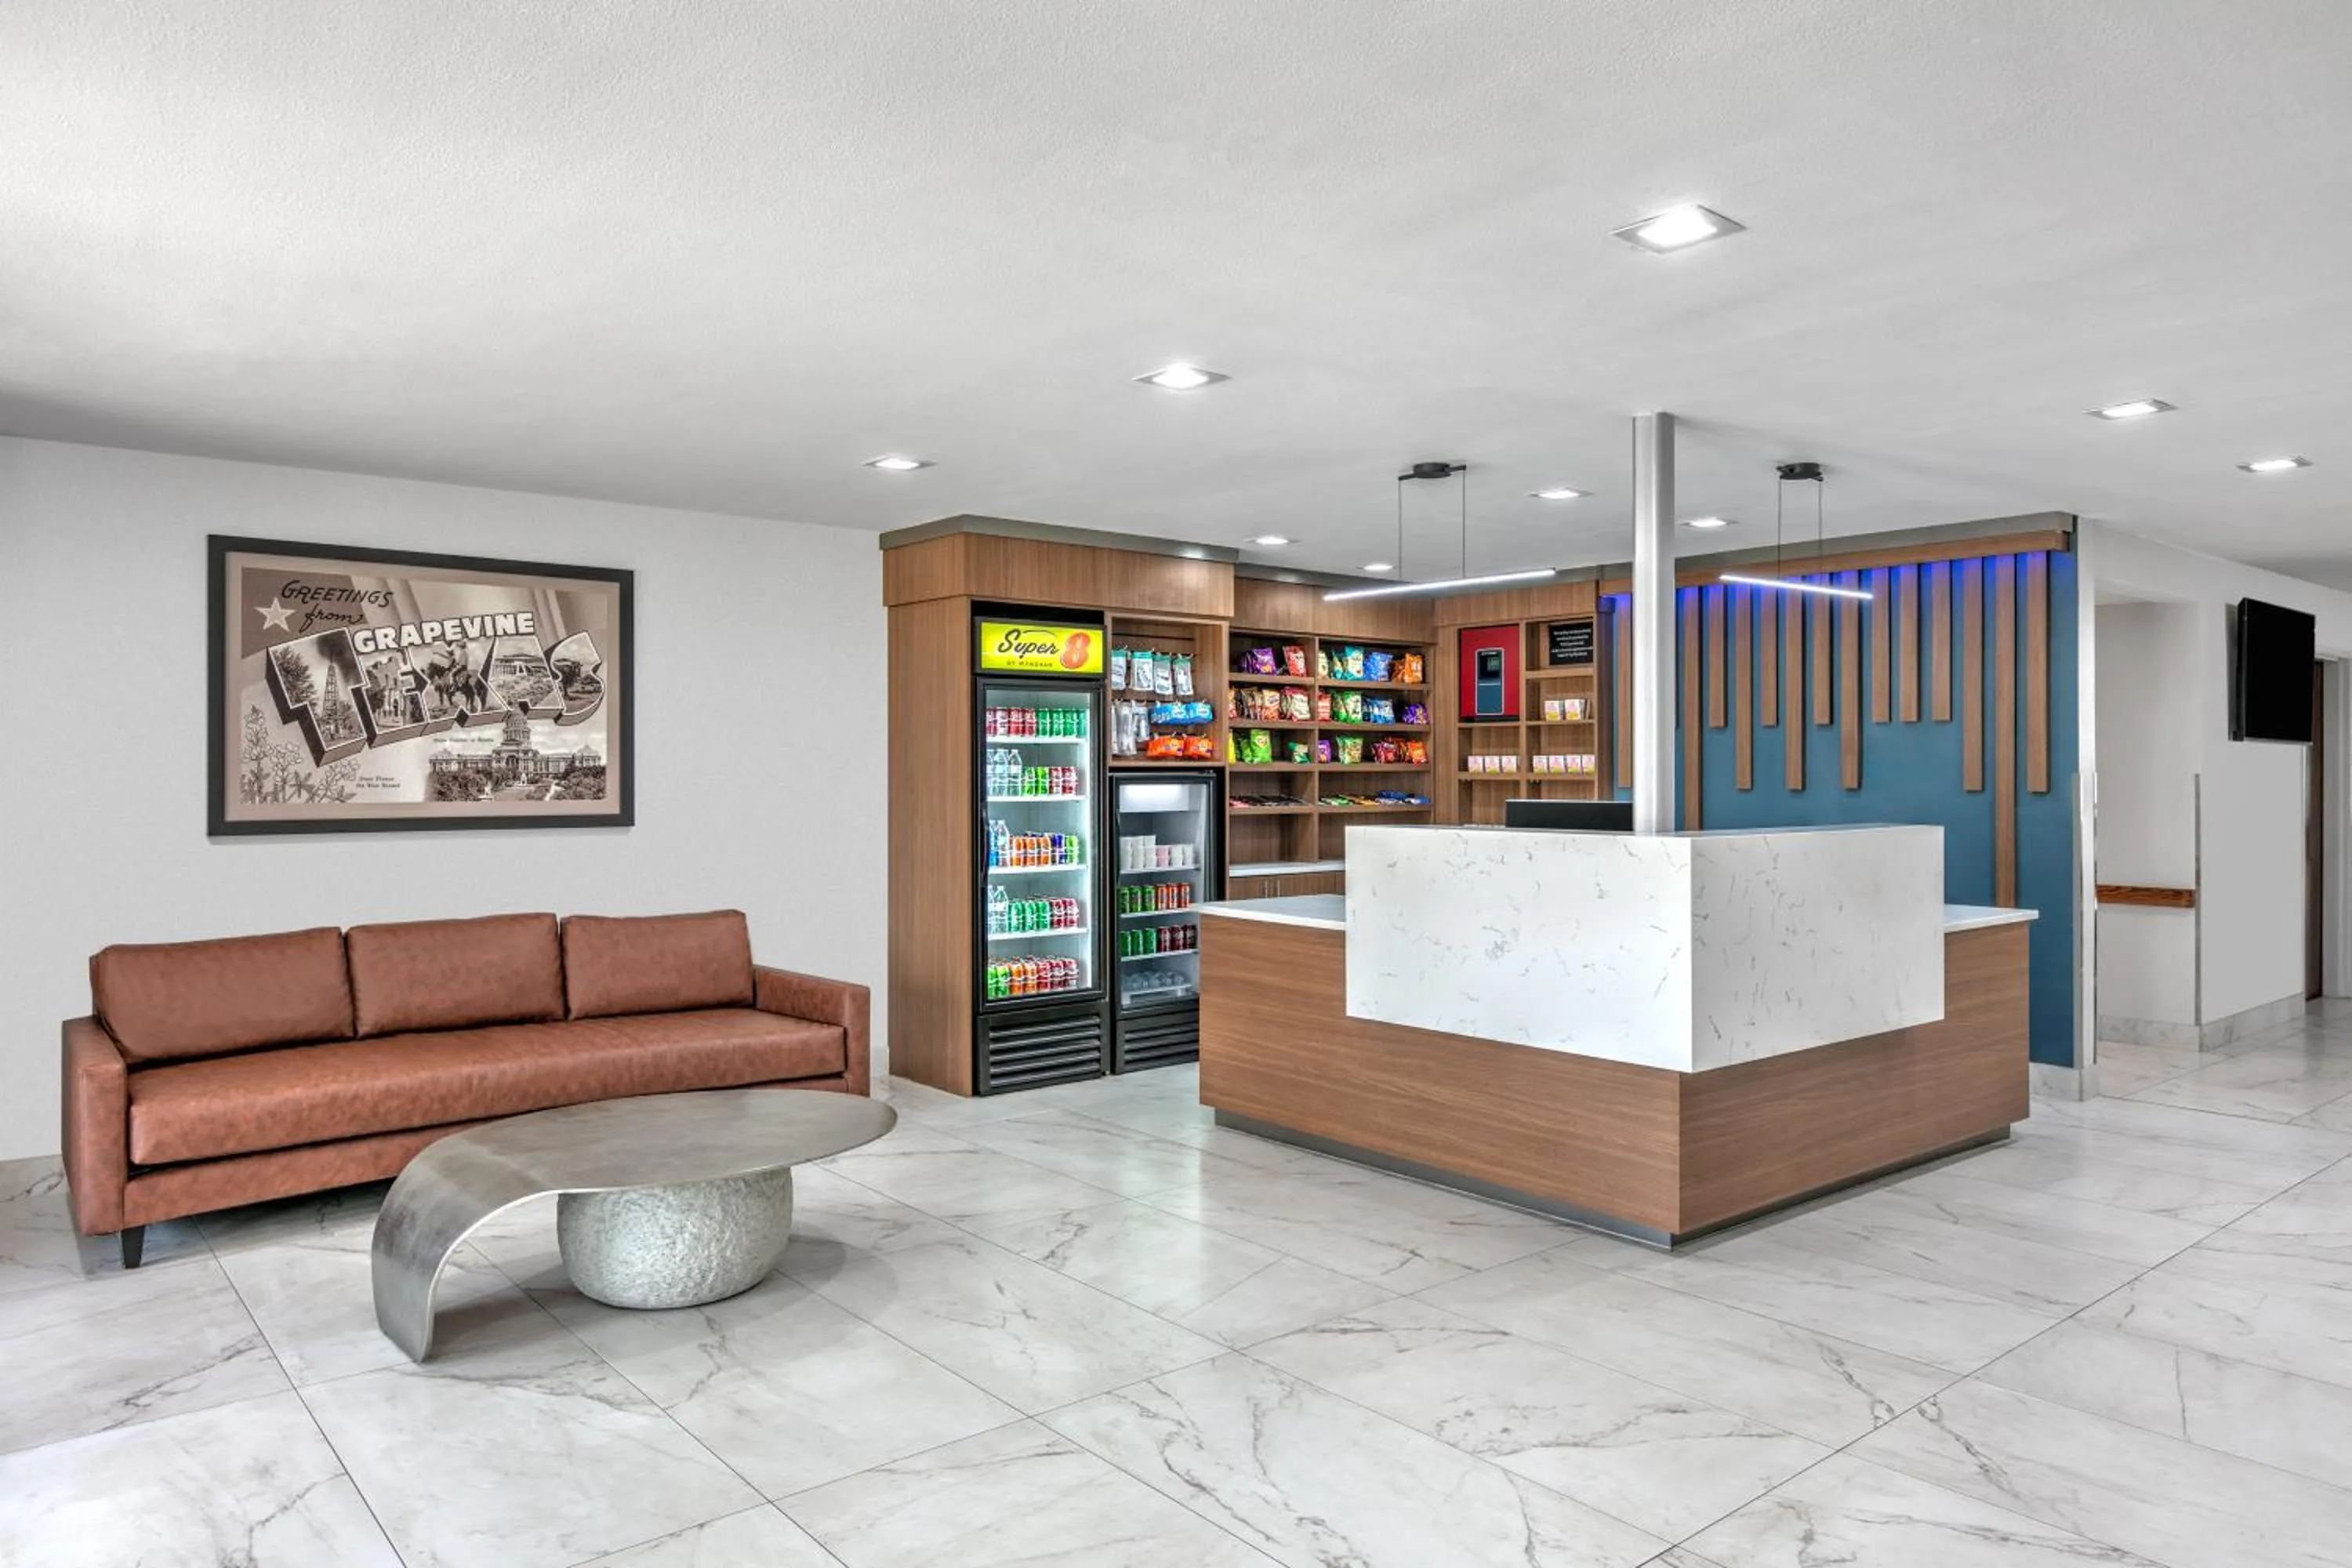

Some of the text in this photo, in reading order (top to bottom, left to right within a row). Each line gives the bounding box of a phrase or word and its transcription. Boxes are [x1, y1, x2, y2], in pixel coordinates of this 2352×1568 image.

[281, 580, 394, 608] GREETINGS
[299, 603, 365, 633] from
[353, 611, 535, 654] GRAPEVINE
[997, 628, 1091, 669] Super 8
[265, 627, 606, 768] TEXAS
